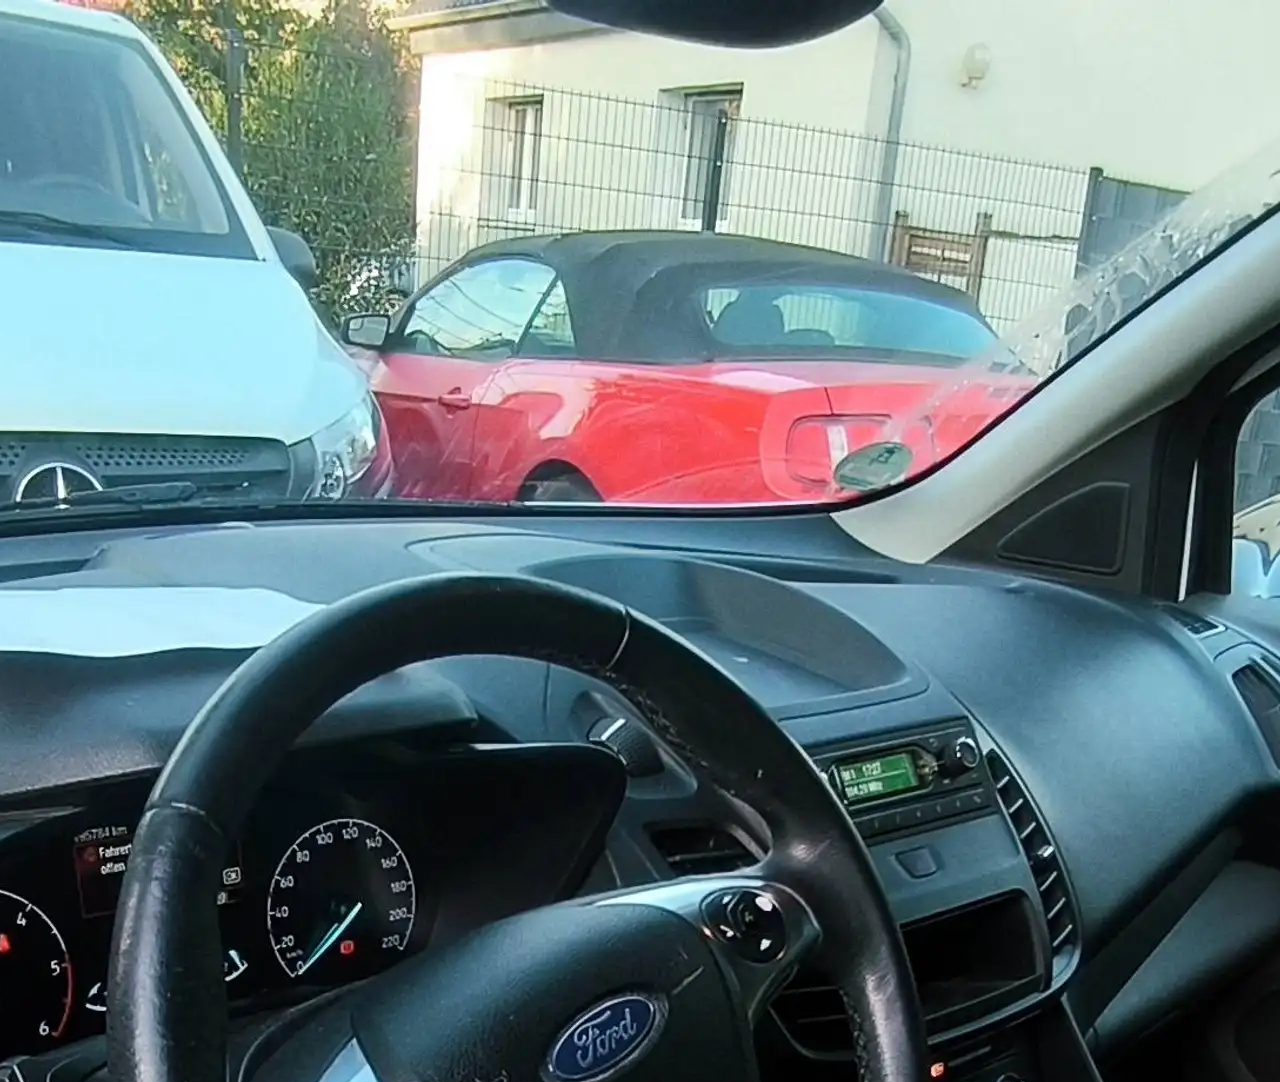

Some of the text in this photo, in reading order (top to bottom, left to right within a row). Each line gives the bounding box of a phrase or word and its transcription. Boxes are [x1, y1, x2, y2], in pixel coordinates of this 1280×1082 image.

[316, 833, 334, 845] 100
[342, 826, 359, 839] 120
[365, 836, 383, 849] 140
[296, 850, 310, 863] 80
[381, 856, 398, 869] 160
[280, 875, 294, 888] 60
[391, 879, 407, 893] 180
[16, 911, 27, 927] 4
[275, 909, 289, 918] 40
[388, 907, 407, 921] 200
[281, 935, 295, 948] 20
[381, 934, 400, 949] 220
[50, 960, 61, 976] 5
[38, 1020, 50, 1036] 6
[573, 1008, 638, 1068] Ford
